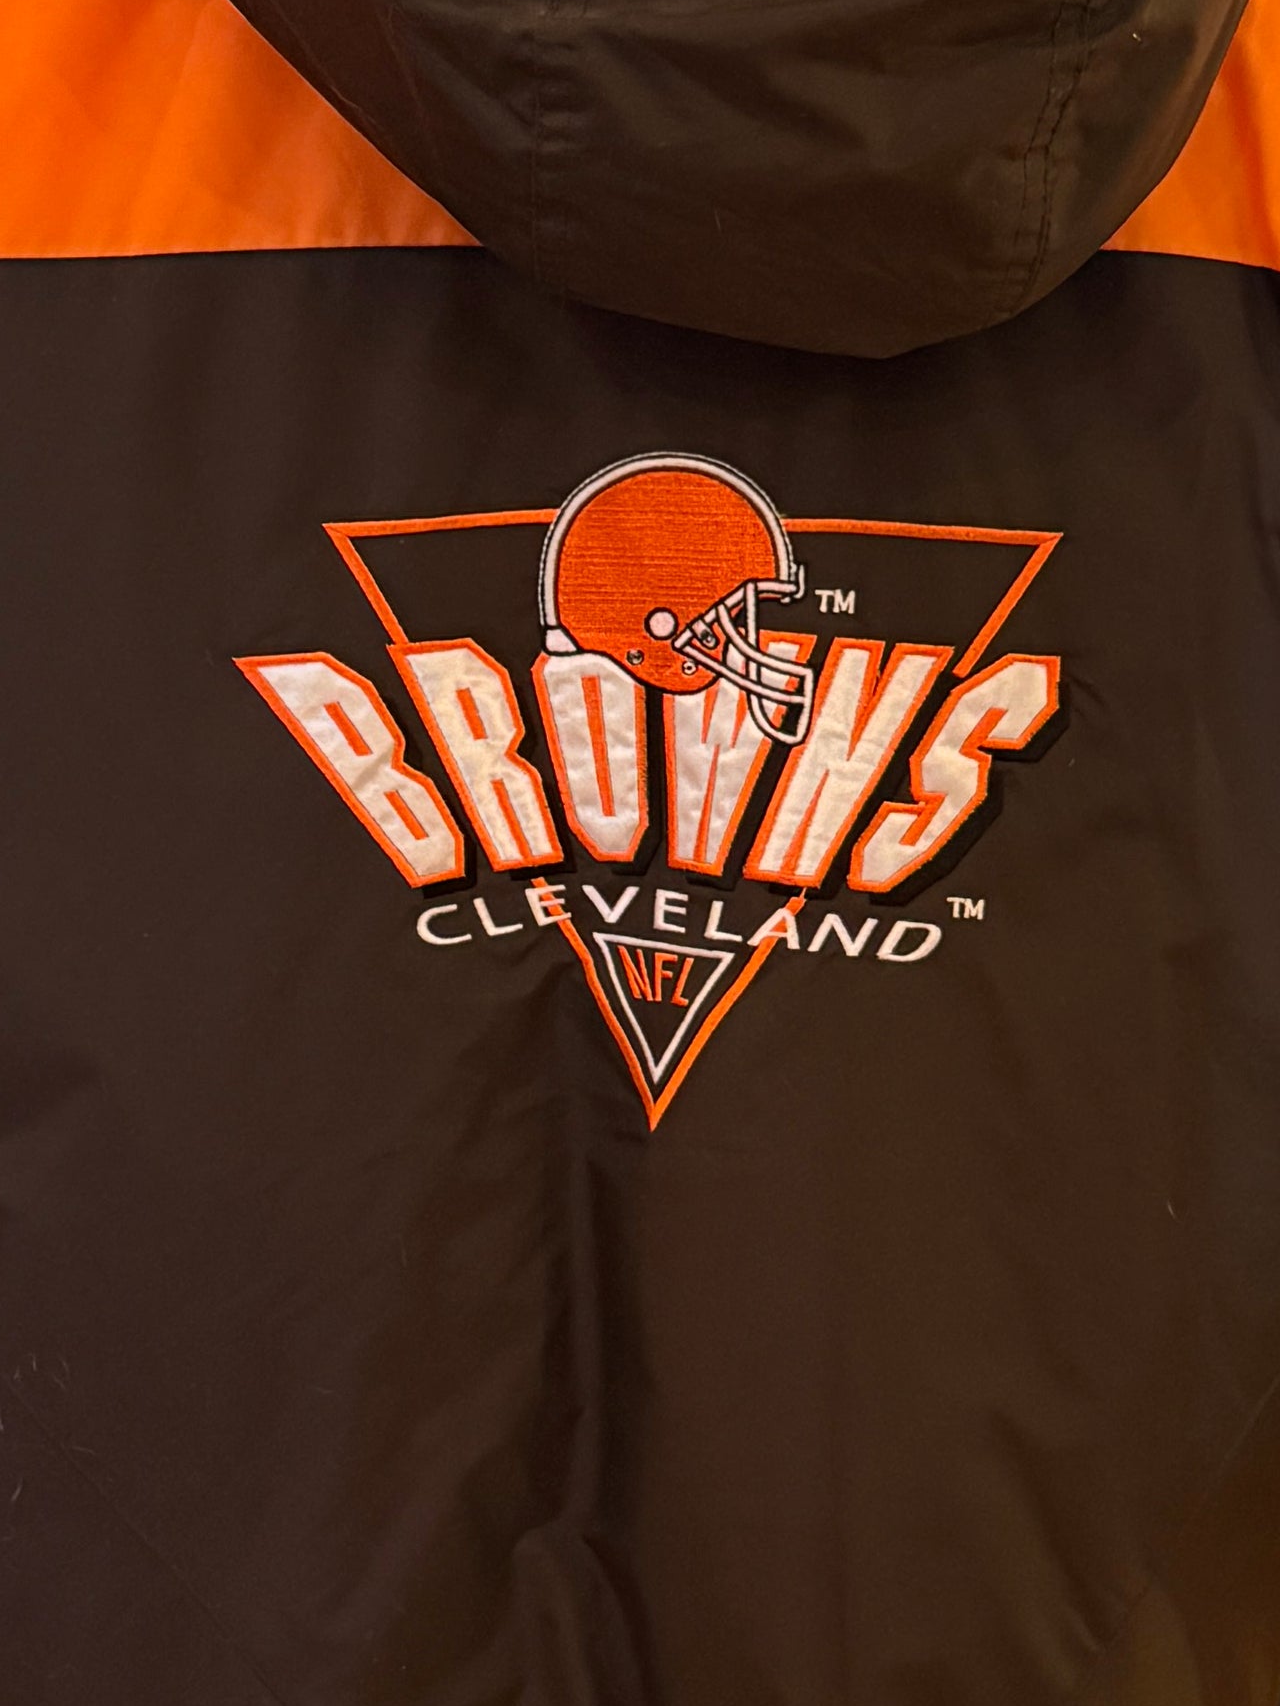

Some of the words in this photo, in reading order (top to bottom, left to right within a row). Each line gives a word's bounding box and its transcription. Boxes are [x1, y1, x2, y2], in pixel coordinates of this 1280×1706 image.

[815, 590, 856, 616] TM
[234, 632, 1062, 892] BROWNS
[416, 884, 942, 963] CLEVELAND
[946, 895, 986, 922] TM
[616, 944, 695, 1007] NFL
